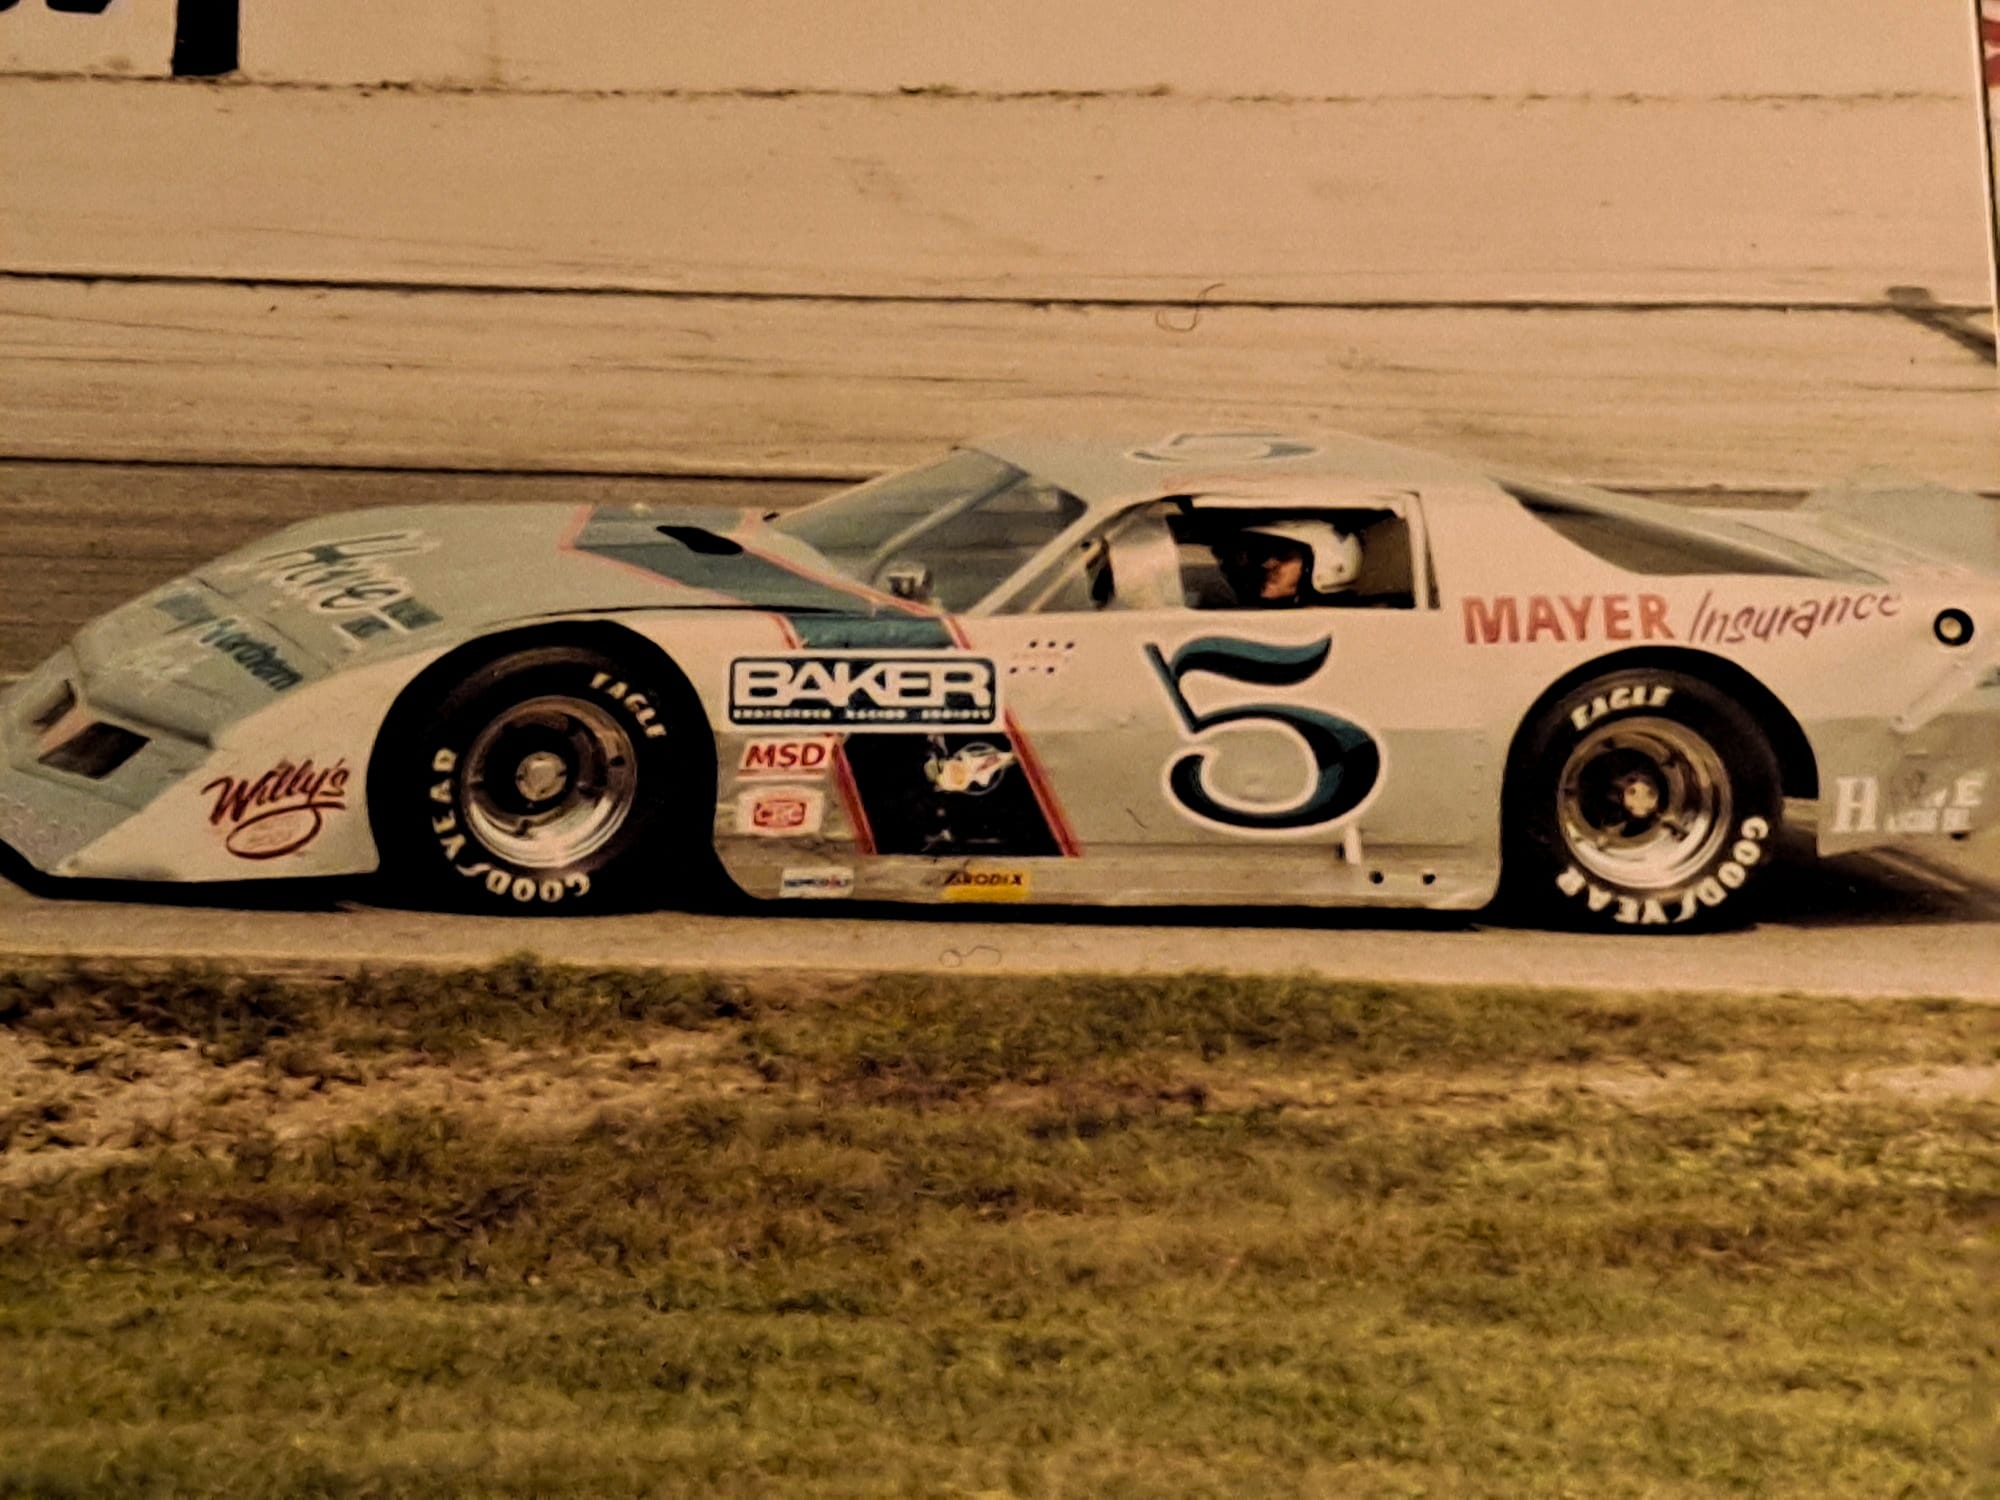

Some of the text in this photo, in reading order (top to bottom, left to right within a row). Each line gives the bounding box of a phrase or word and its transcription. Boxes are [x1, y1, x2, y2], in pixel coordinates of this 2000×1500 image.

[1461, 590, 1900, 644] MAYER Insurance
[733, 660, 993, 708] BAKER
[1570, 685, 1674, 732] EAGLE
[744, 742, 827, 768] MSD
[1144, 634, 1382, 831] 5
[200, 757, 350, 859] Willy's
